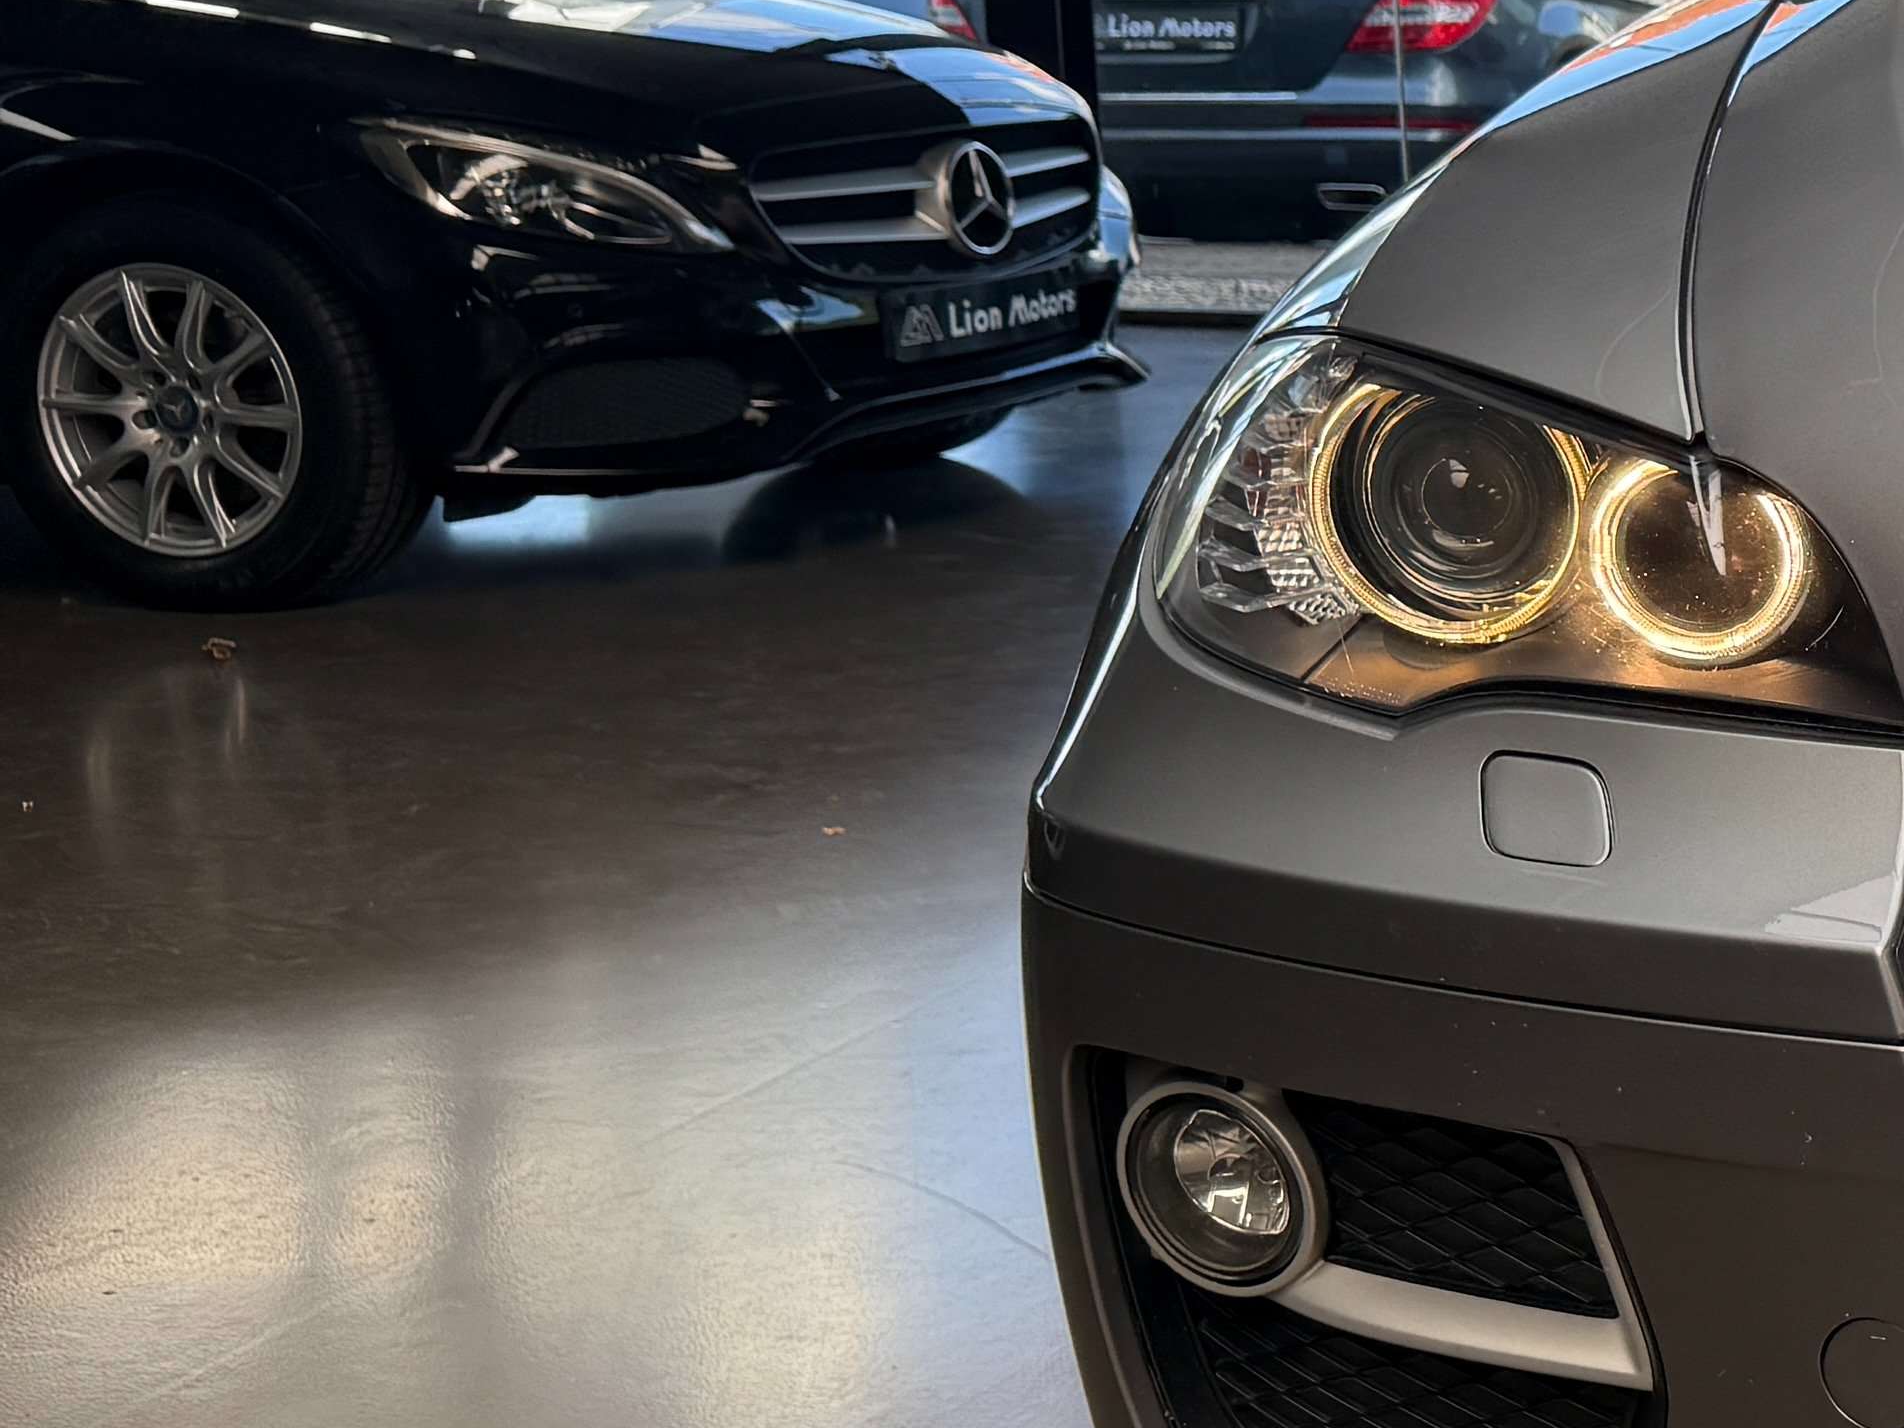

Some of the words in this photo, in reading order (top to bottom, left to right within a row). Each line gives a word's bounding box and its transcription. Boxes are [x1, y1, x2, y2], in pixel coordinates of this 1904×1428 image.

[1108, 13, 1155, 38] Lion
[1158, 17, 1237, 38] Motors
[947, 298, 1004, 339] Lion
[1008, 288, 1077, 328] Motors
